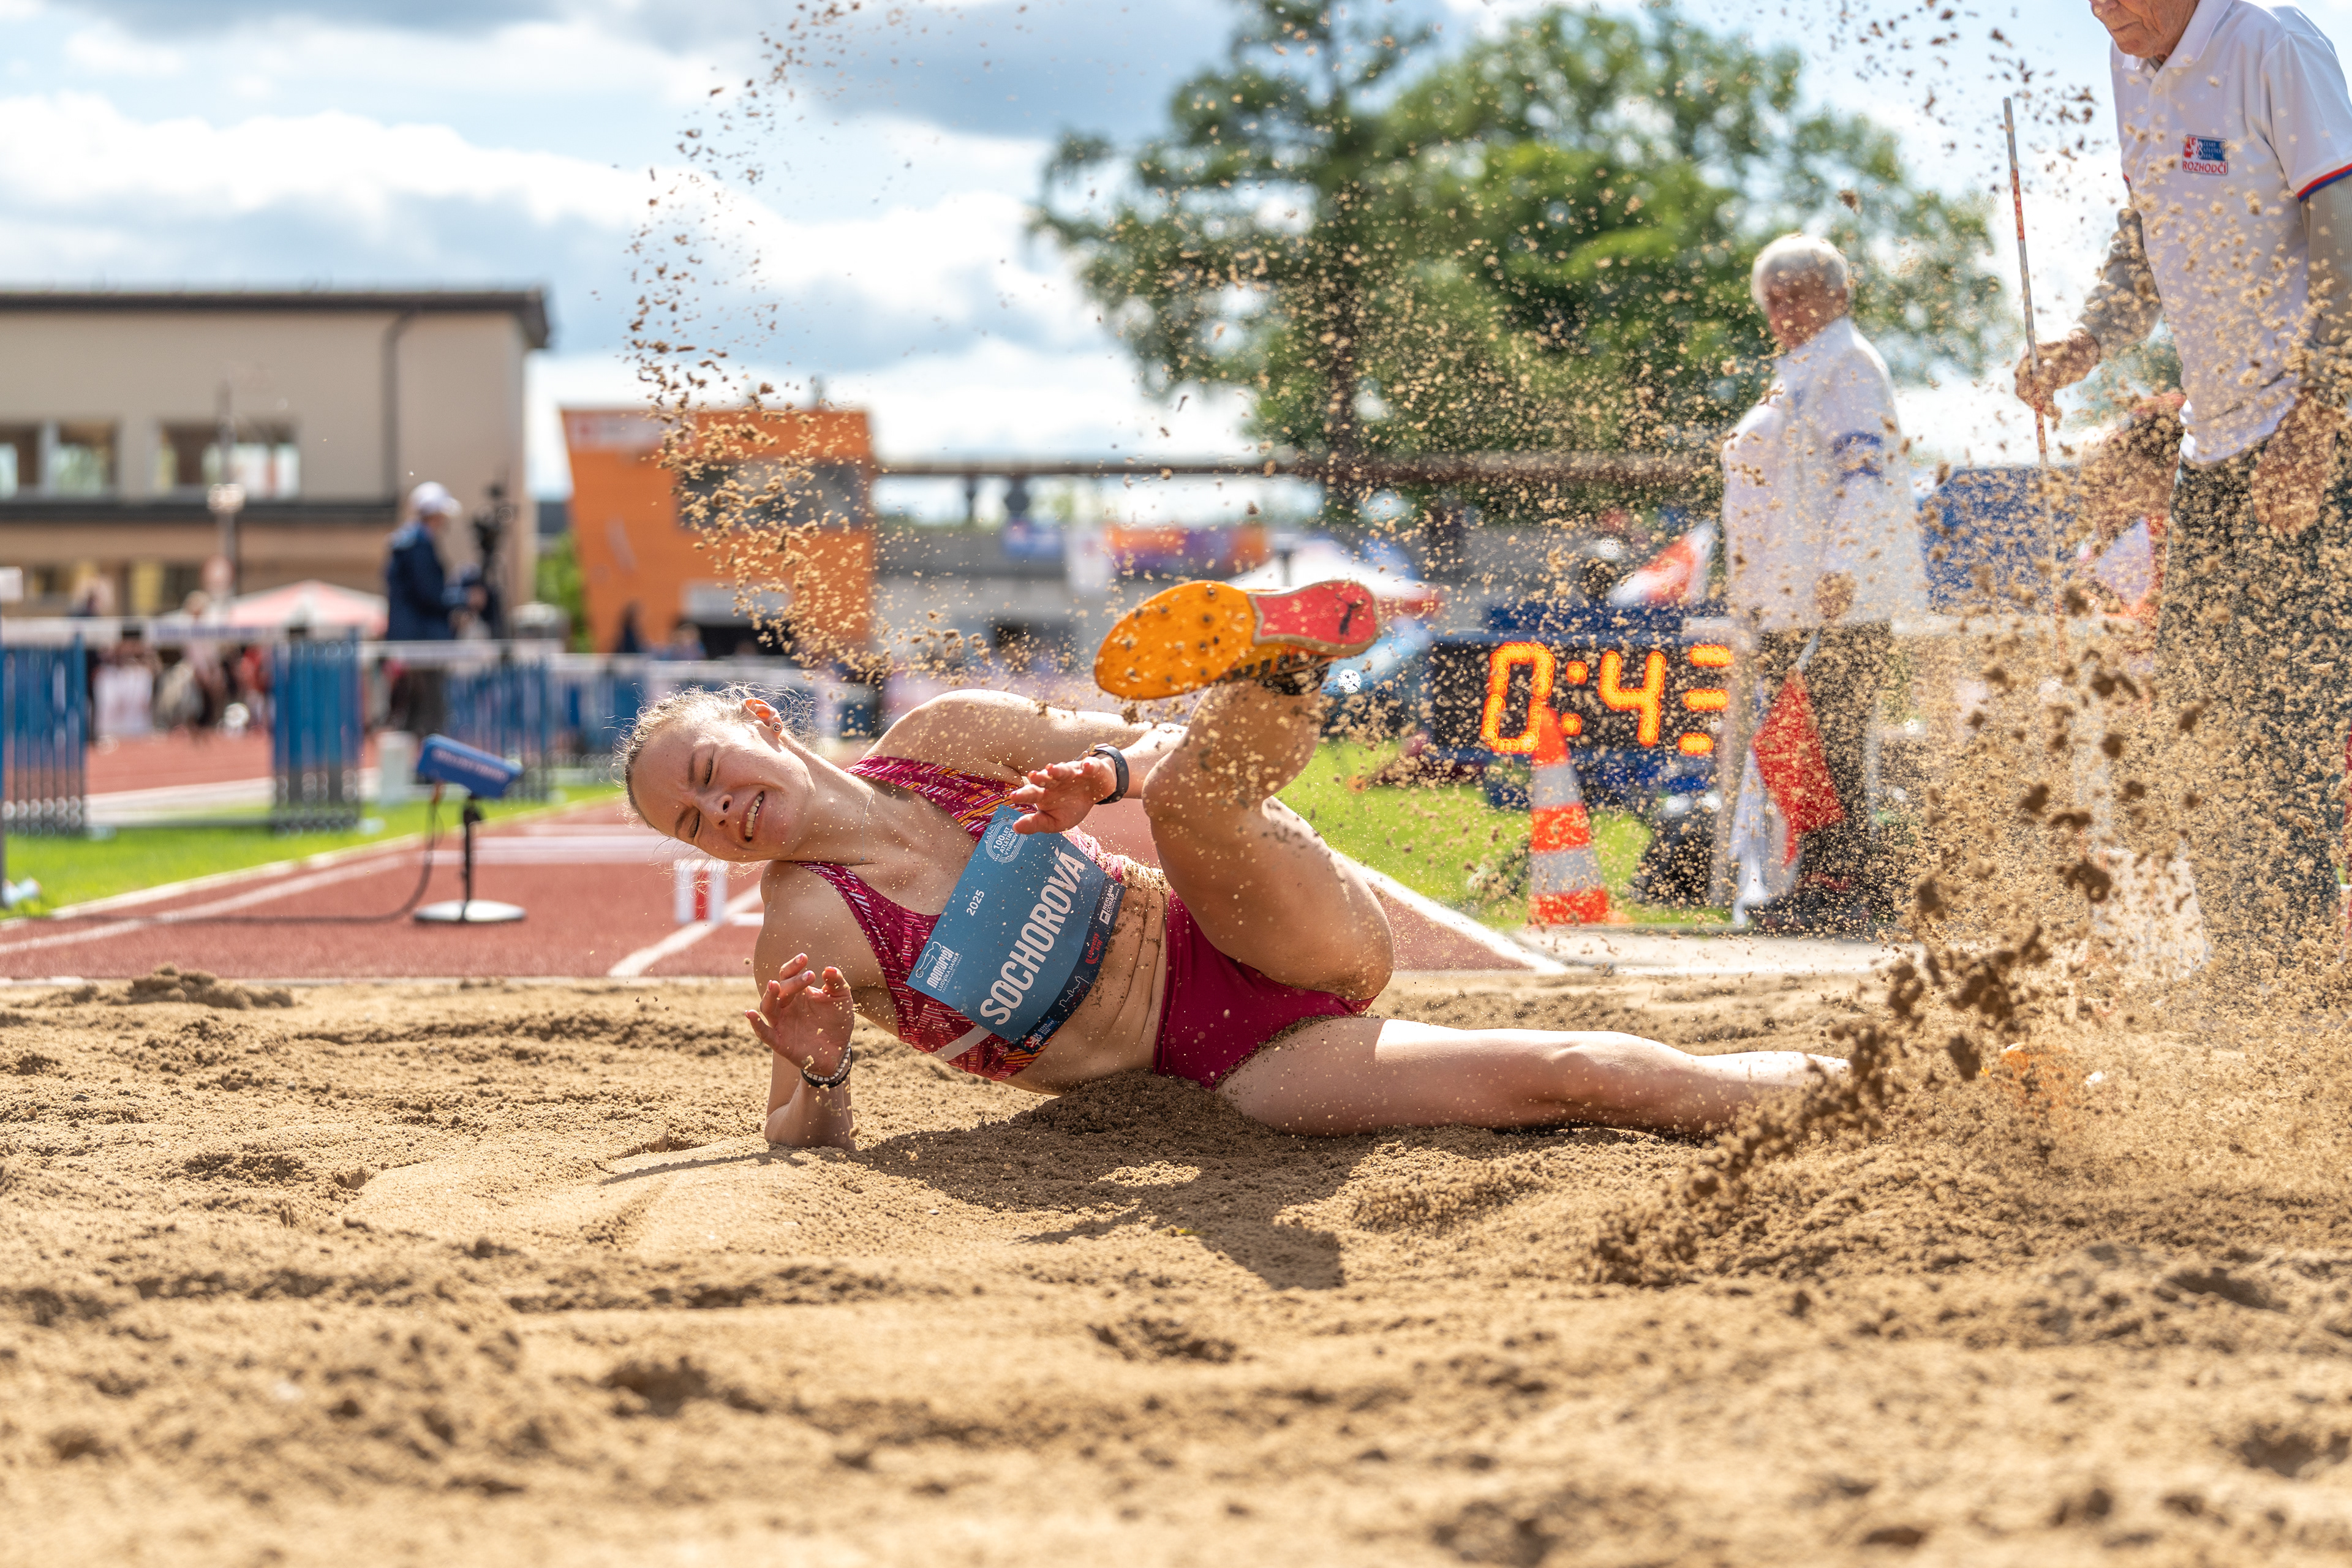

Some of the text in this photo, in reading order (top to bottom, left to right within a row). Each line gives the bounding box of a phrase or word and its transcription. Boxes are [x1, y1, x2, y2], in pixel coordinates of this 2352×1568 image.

[2183, 160, 2226, 173] ROZHODČÍ
[993, 835, 1005, 849] 100
[1000, 829, 1014, 853] ATLETIKY
[1006, 833, 1018, 851] TURNOV
[967, 889, 984, 916] 2025
[1102, 884, 1114, 910] REKLAMA
[1106, 893, 1115, 913] CORAP
[980, 846, 1085, 1025] SOCHOROVÁ
[937, 953, 960, 991] LUDVÍKA DAŇKA
